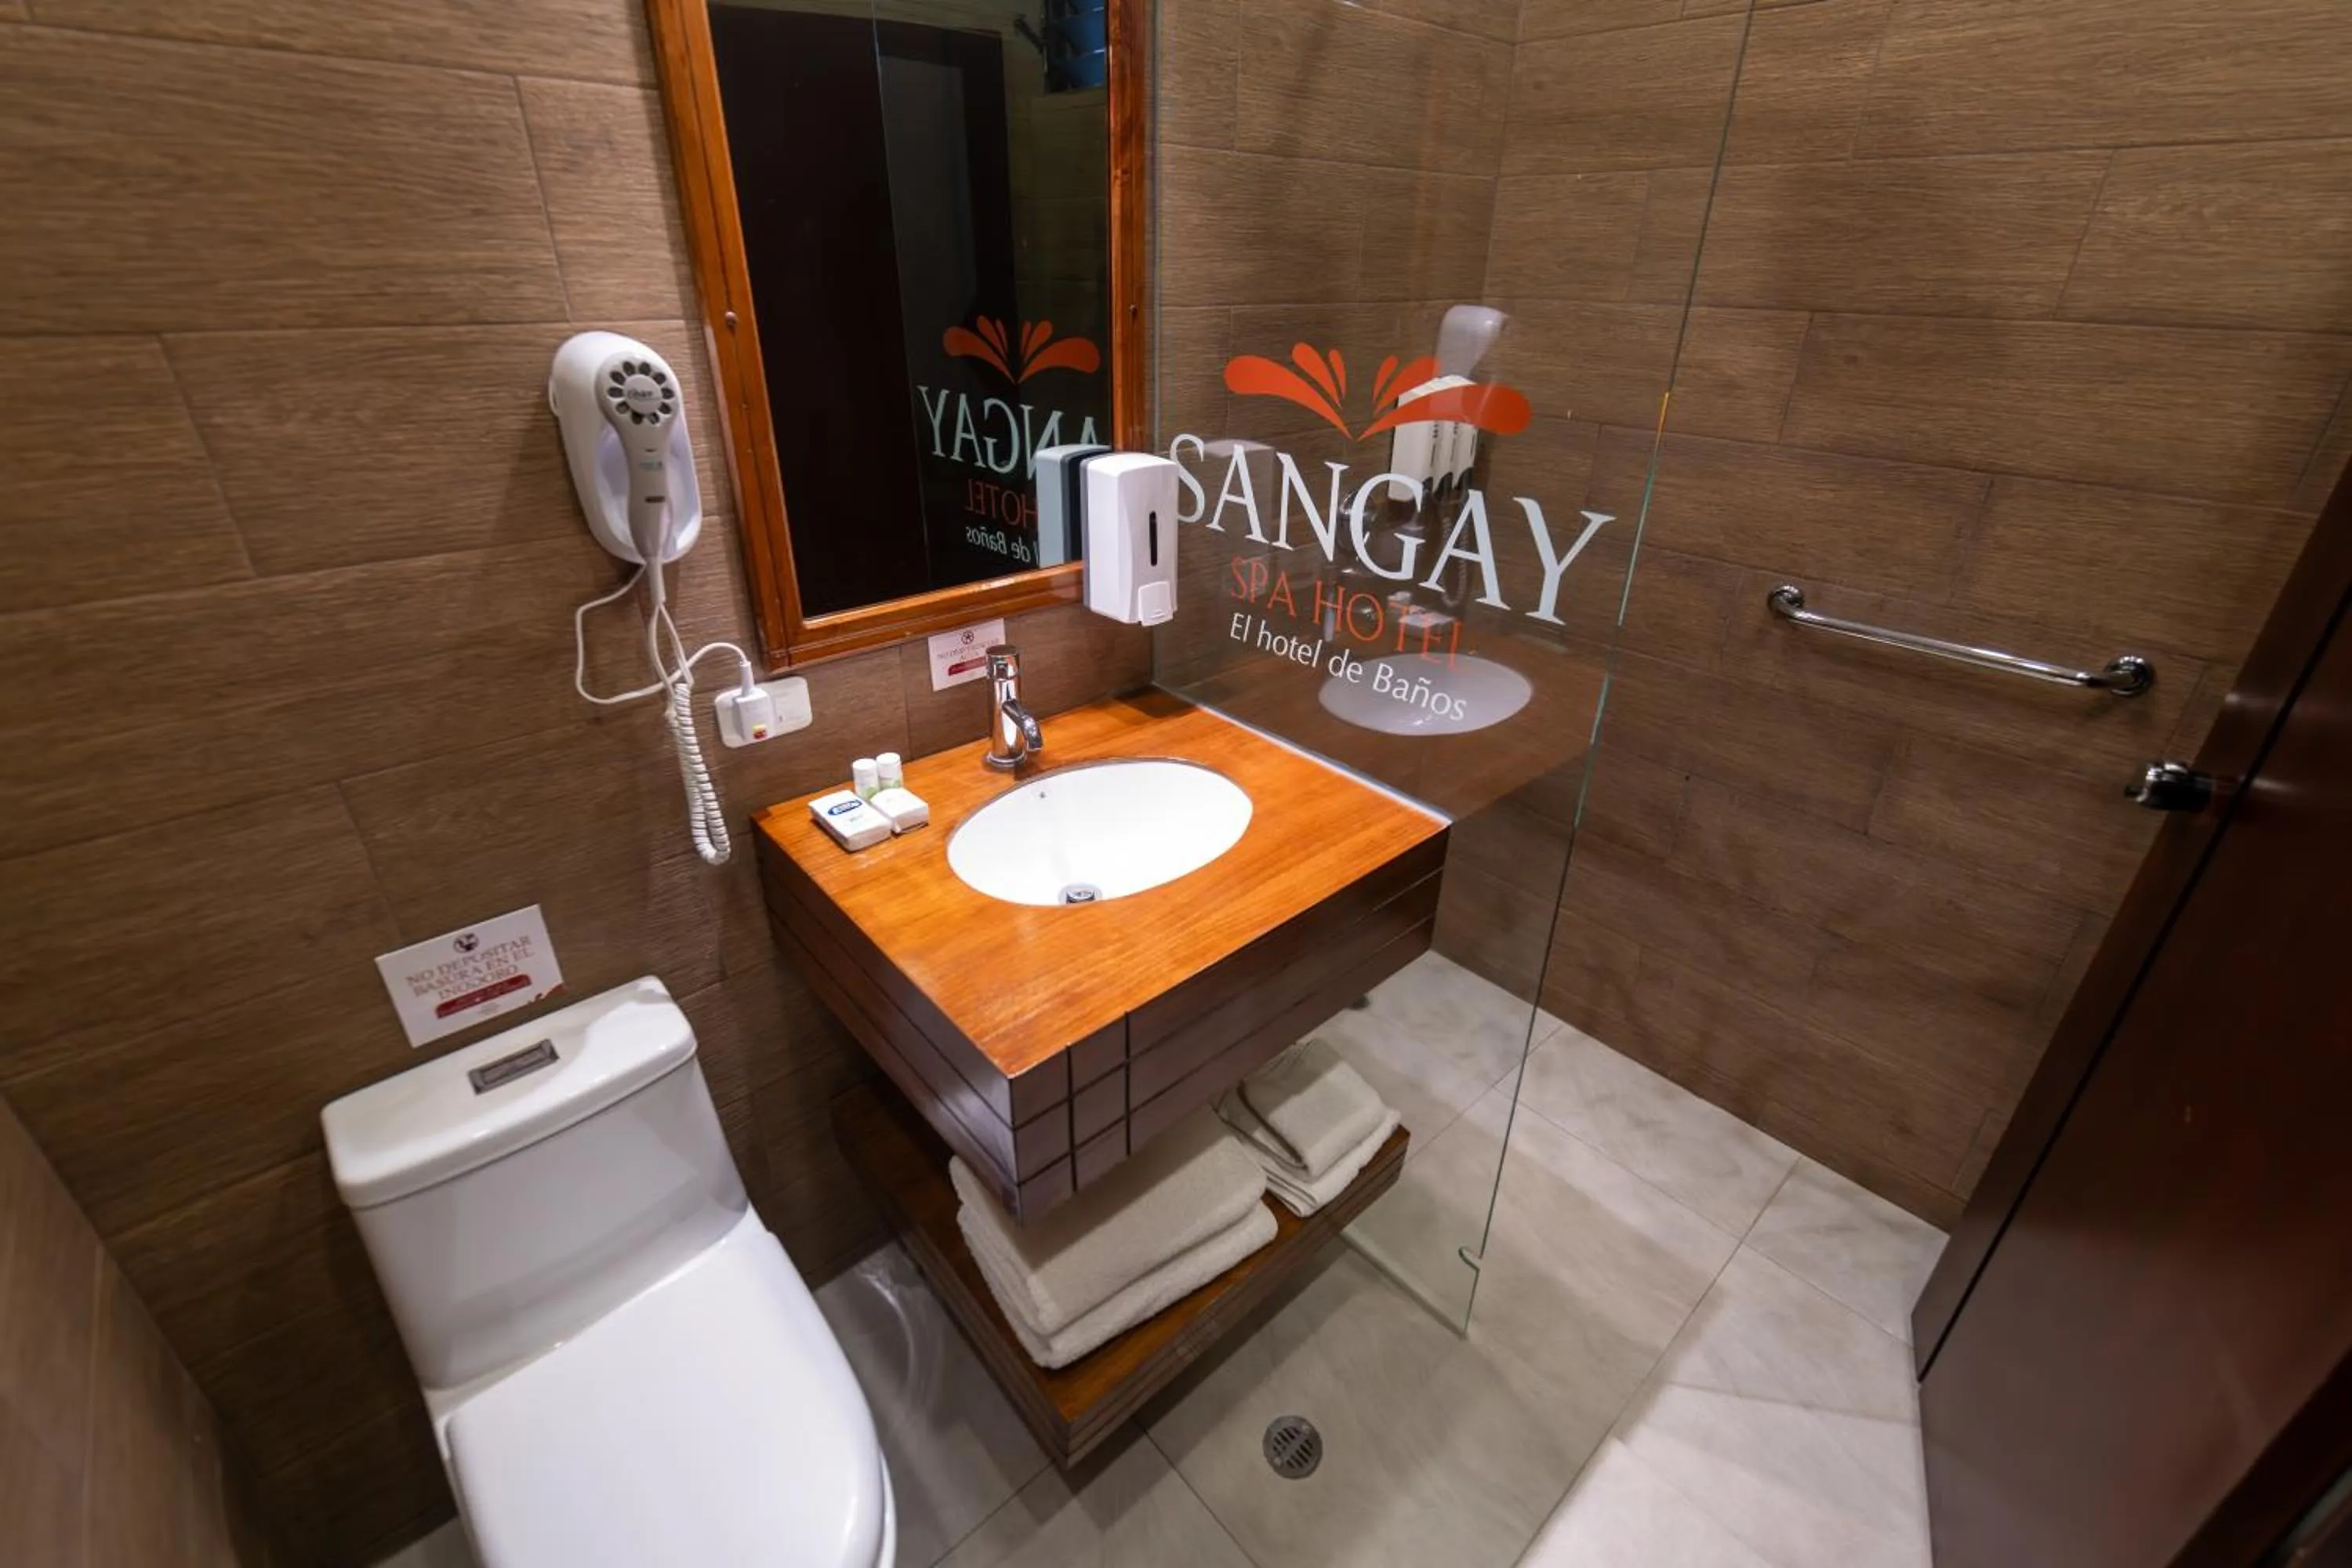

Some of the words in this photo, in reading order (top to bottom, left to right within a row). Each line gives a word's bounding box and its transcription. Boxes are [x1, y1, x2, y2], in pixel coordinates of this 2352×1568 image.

[1169, 434, 1617, 626] SANGAY
[1229, 612, 1252, 641] El
[1257, 623, 1323, 668] hotel
[1328, 648, 1363, 684] de
[1373, 662, 1468, 721] Baños
[1230, 556, 1297, 618] SPA
[1313, 580, 1474, 675] HOTEL
[405, 968, 434, 987] NO
[437, 935, 533, 978] DEPOSITAR
